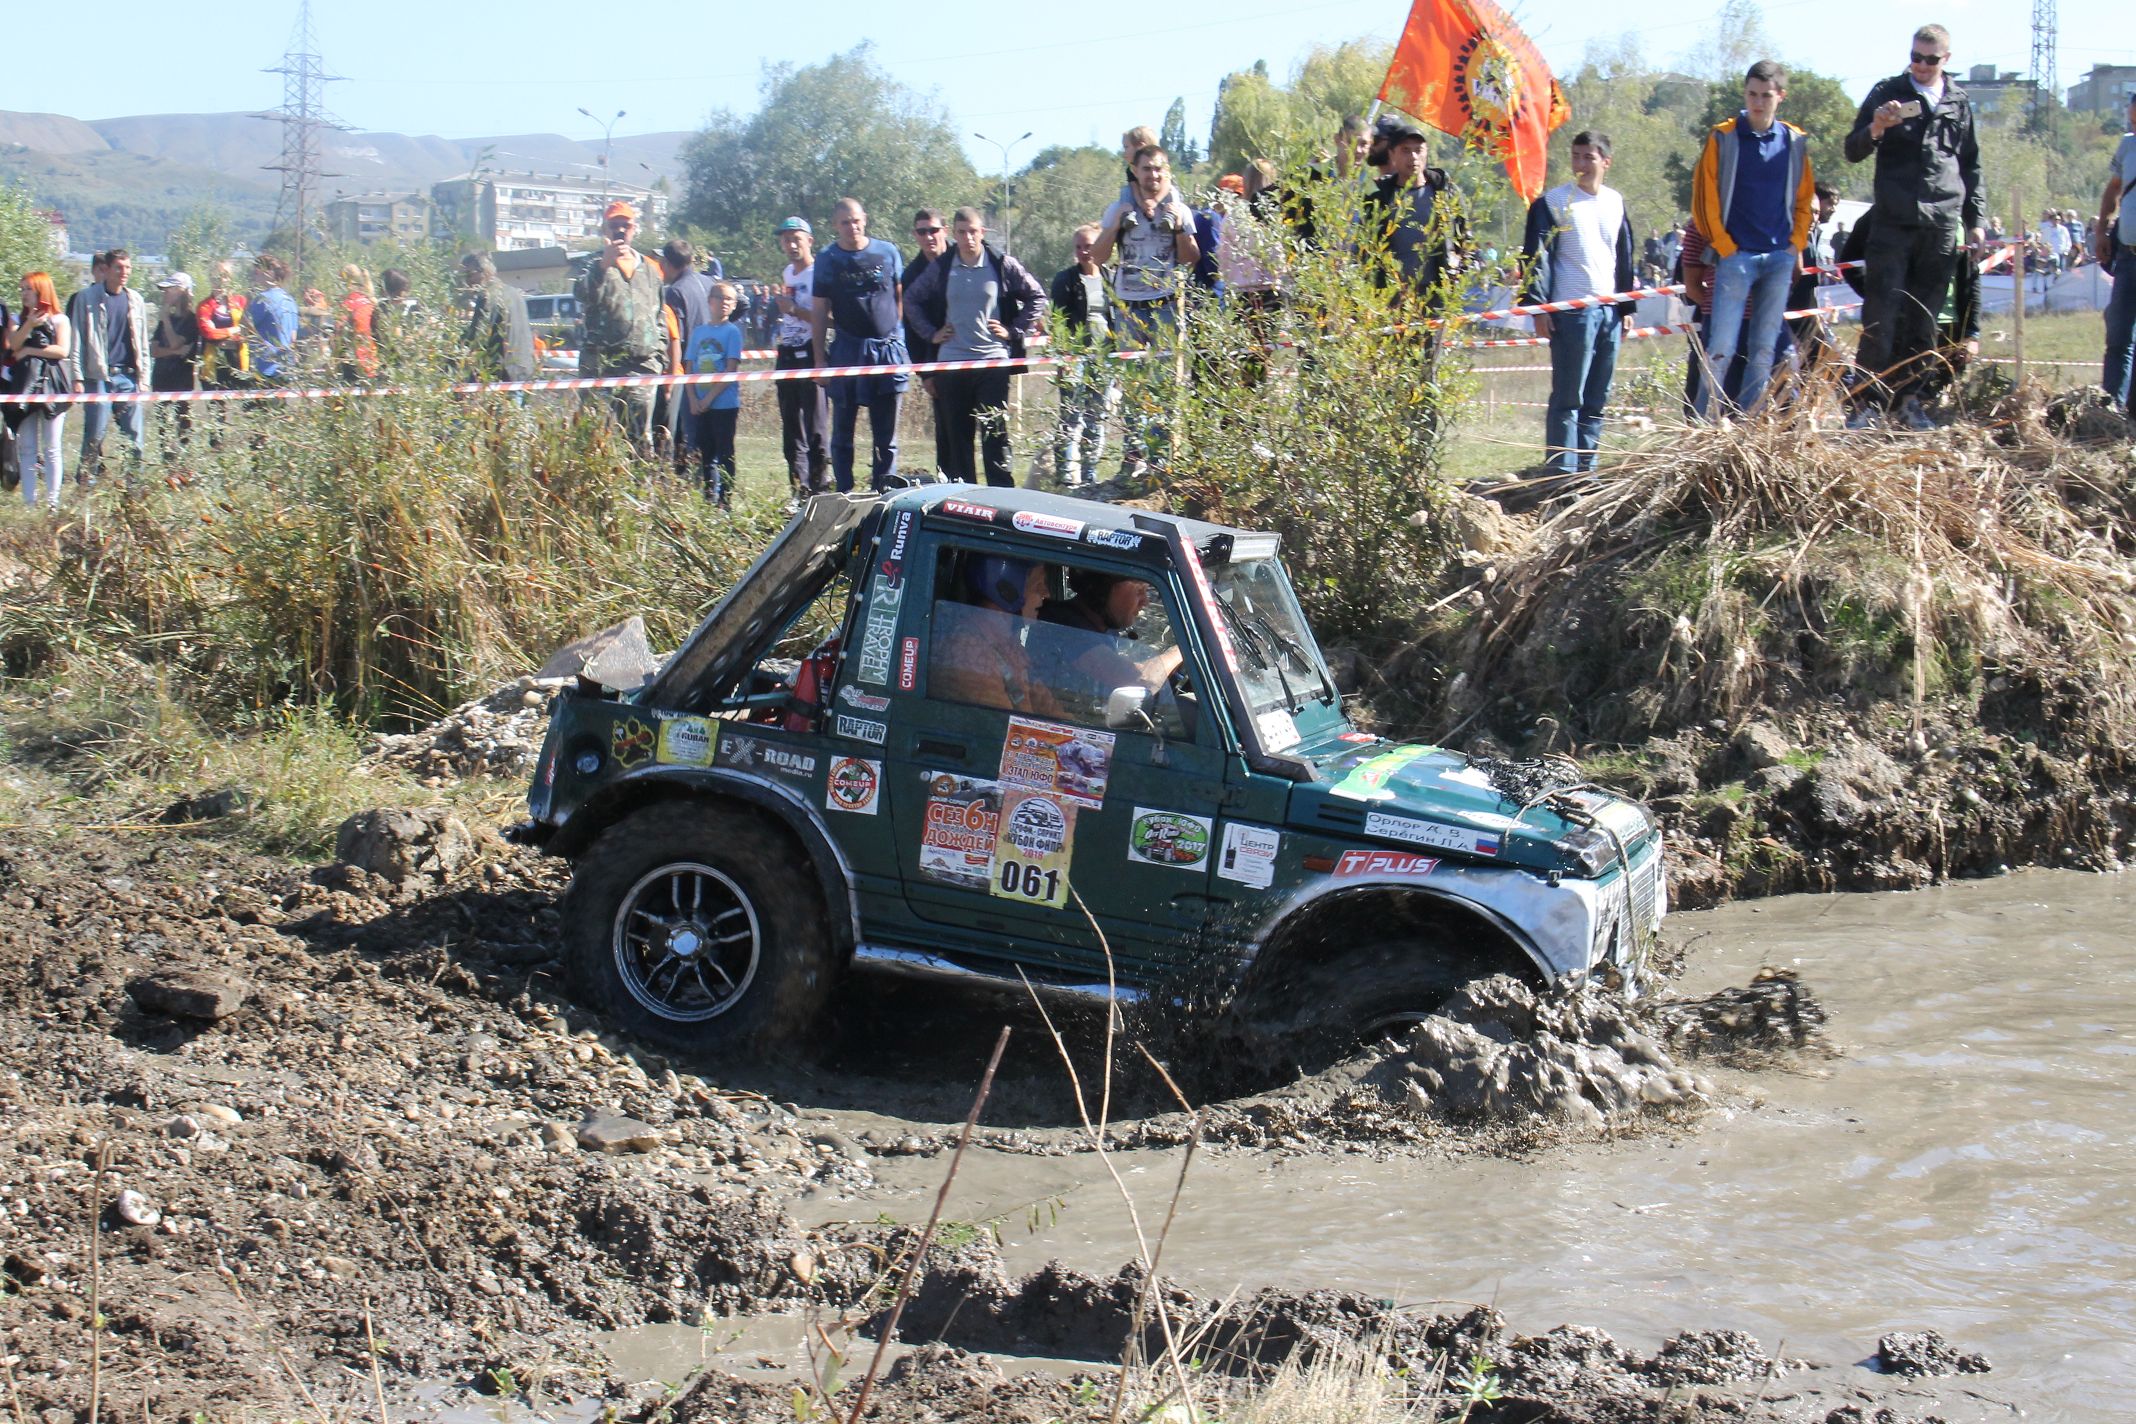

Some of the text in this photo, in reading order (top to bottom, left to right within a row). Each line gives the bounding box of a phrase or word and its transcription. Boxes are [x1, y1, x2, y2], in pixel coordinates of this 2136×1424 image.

[946, 502, 993, 518] VIAIR
[890, 511, 912, 560] Runva
[1096, 529, 1134, 546] RAPTOR
[861, 615, 883, 673] TRAVEL
[872, 614, 896, 682] TROPHY
[901, 640, 915, 688] COMEUP
[837, 715, 886, 743] RAPTOR
[780, 766, 813, 778] media.ru
[1008, 765, 1028, 776] ЭТАП
[1030, 769, 1054, 784] ЮФО
[834, 779, 871, 788] COMEUP
[925, 828, 995, 853] ДОЖДЕЙ
[1176, 839, 1207, 852] 2017
[1240, 833, 1275, 850] ЦЕНТР
[1344, 855, 1430, 873] T PLUS
[1001, 860, 1060, 901] 061
